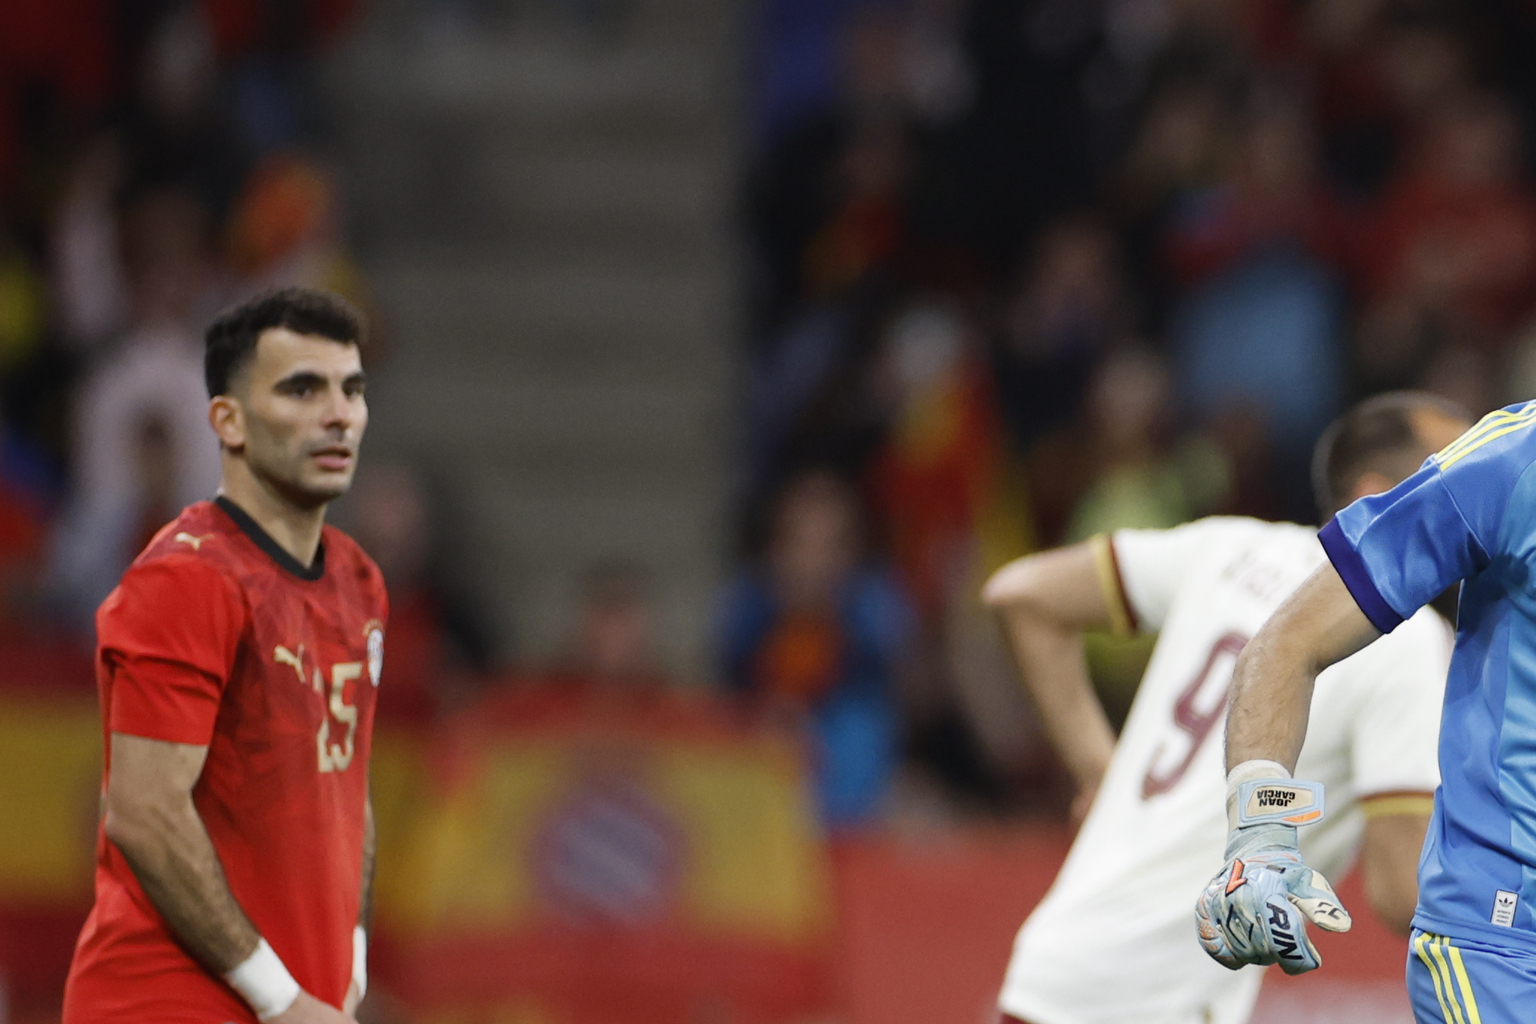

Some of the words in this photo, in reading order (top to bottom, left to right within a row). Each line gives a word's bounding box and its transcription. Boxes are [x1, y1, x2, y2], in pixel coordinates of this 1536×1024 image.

[1140, 631, 1250, 801] 9
[1257, 789, 1296, 800] GARCIA
[1258, 798, 1292, 807] JOAN
[1265, 901, 1304, 961] RIN
